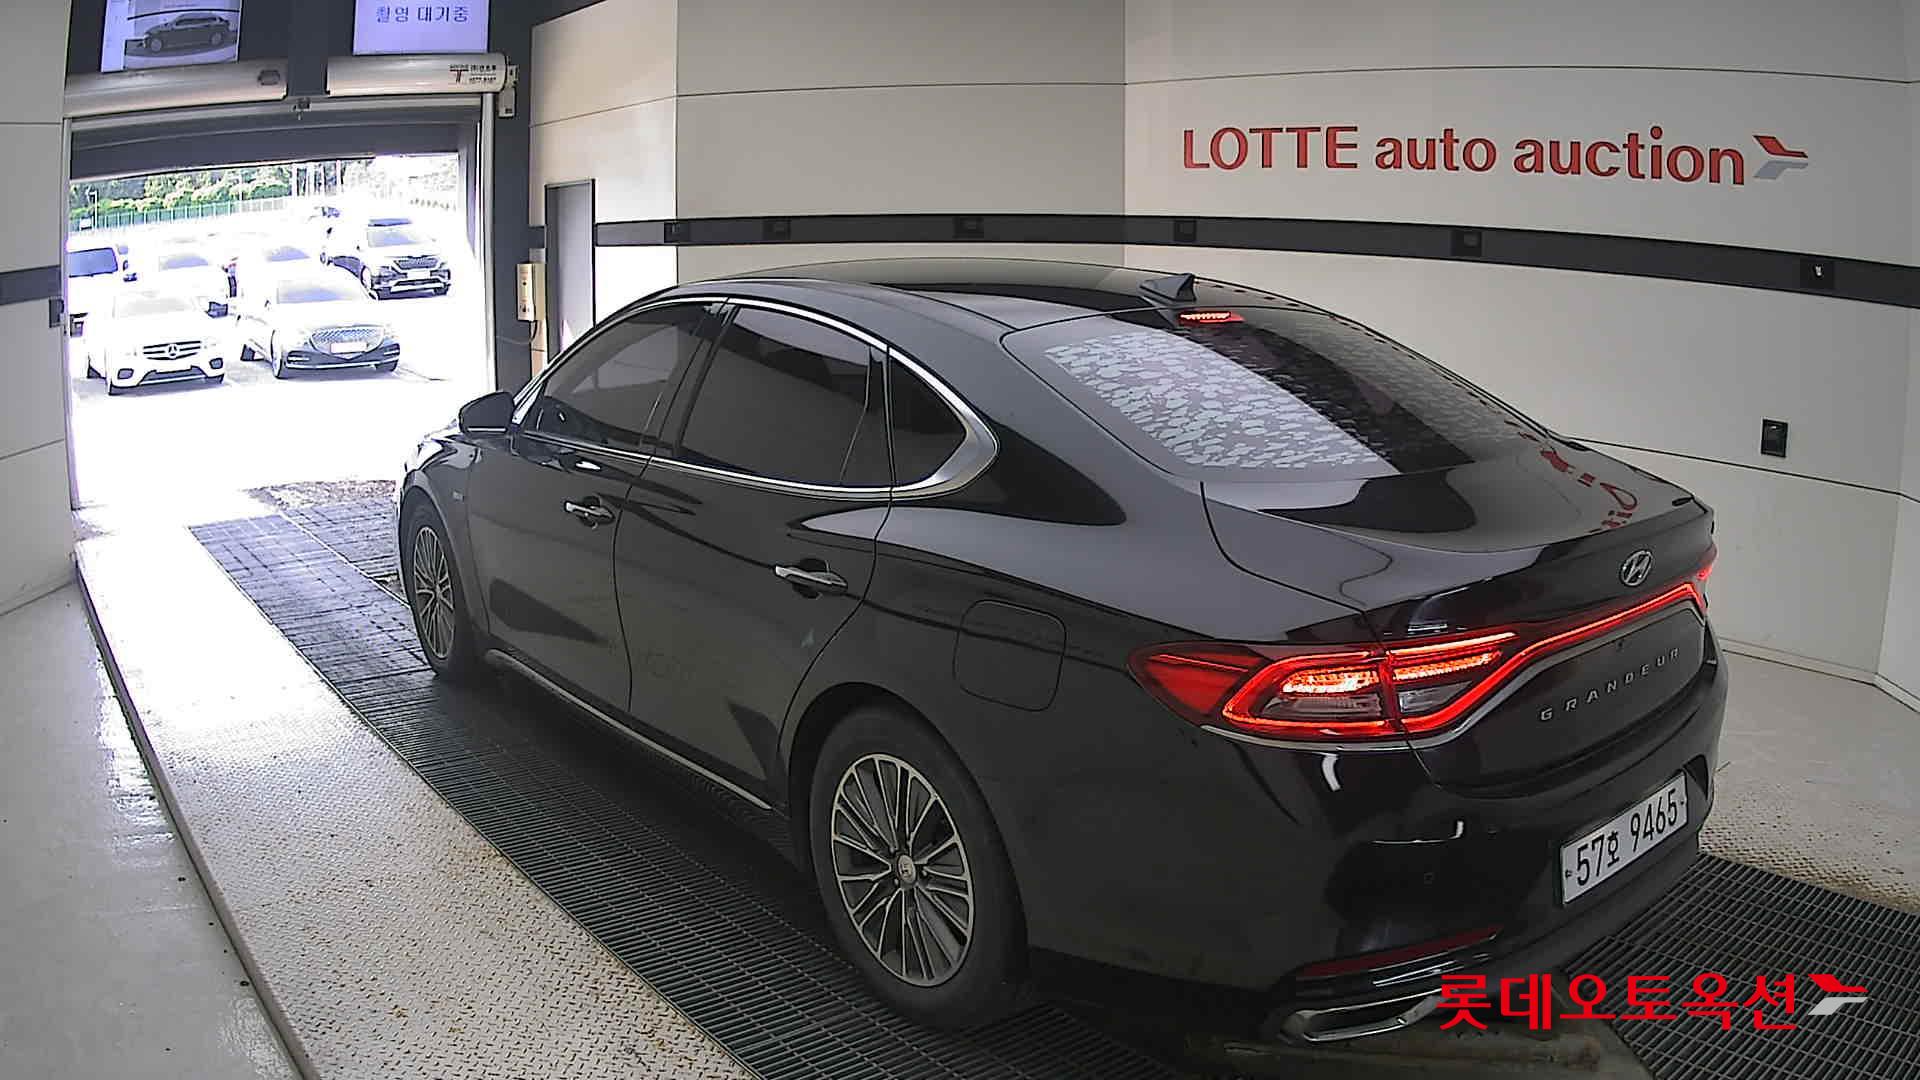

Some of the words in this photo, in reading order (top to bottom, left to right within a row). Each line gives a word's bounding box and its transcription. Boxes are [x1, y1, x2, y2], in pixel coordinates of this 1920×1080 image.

[417, 5, 468, 23] 대기중
[1183, 126, 1358, 170] LOTTE
[1375, 127, 1498, 172] auto
[1513, 125, 1745, 186] auction
[1540, 648, 1680, 721] GRANDEUR
[1576, 831, 1620, 886] 57호
[1630, 788, 1678, 852] 9465
